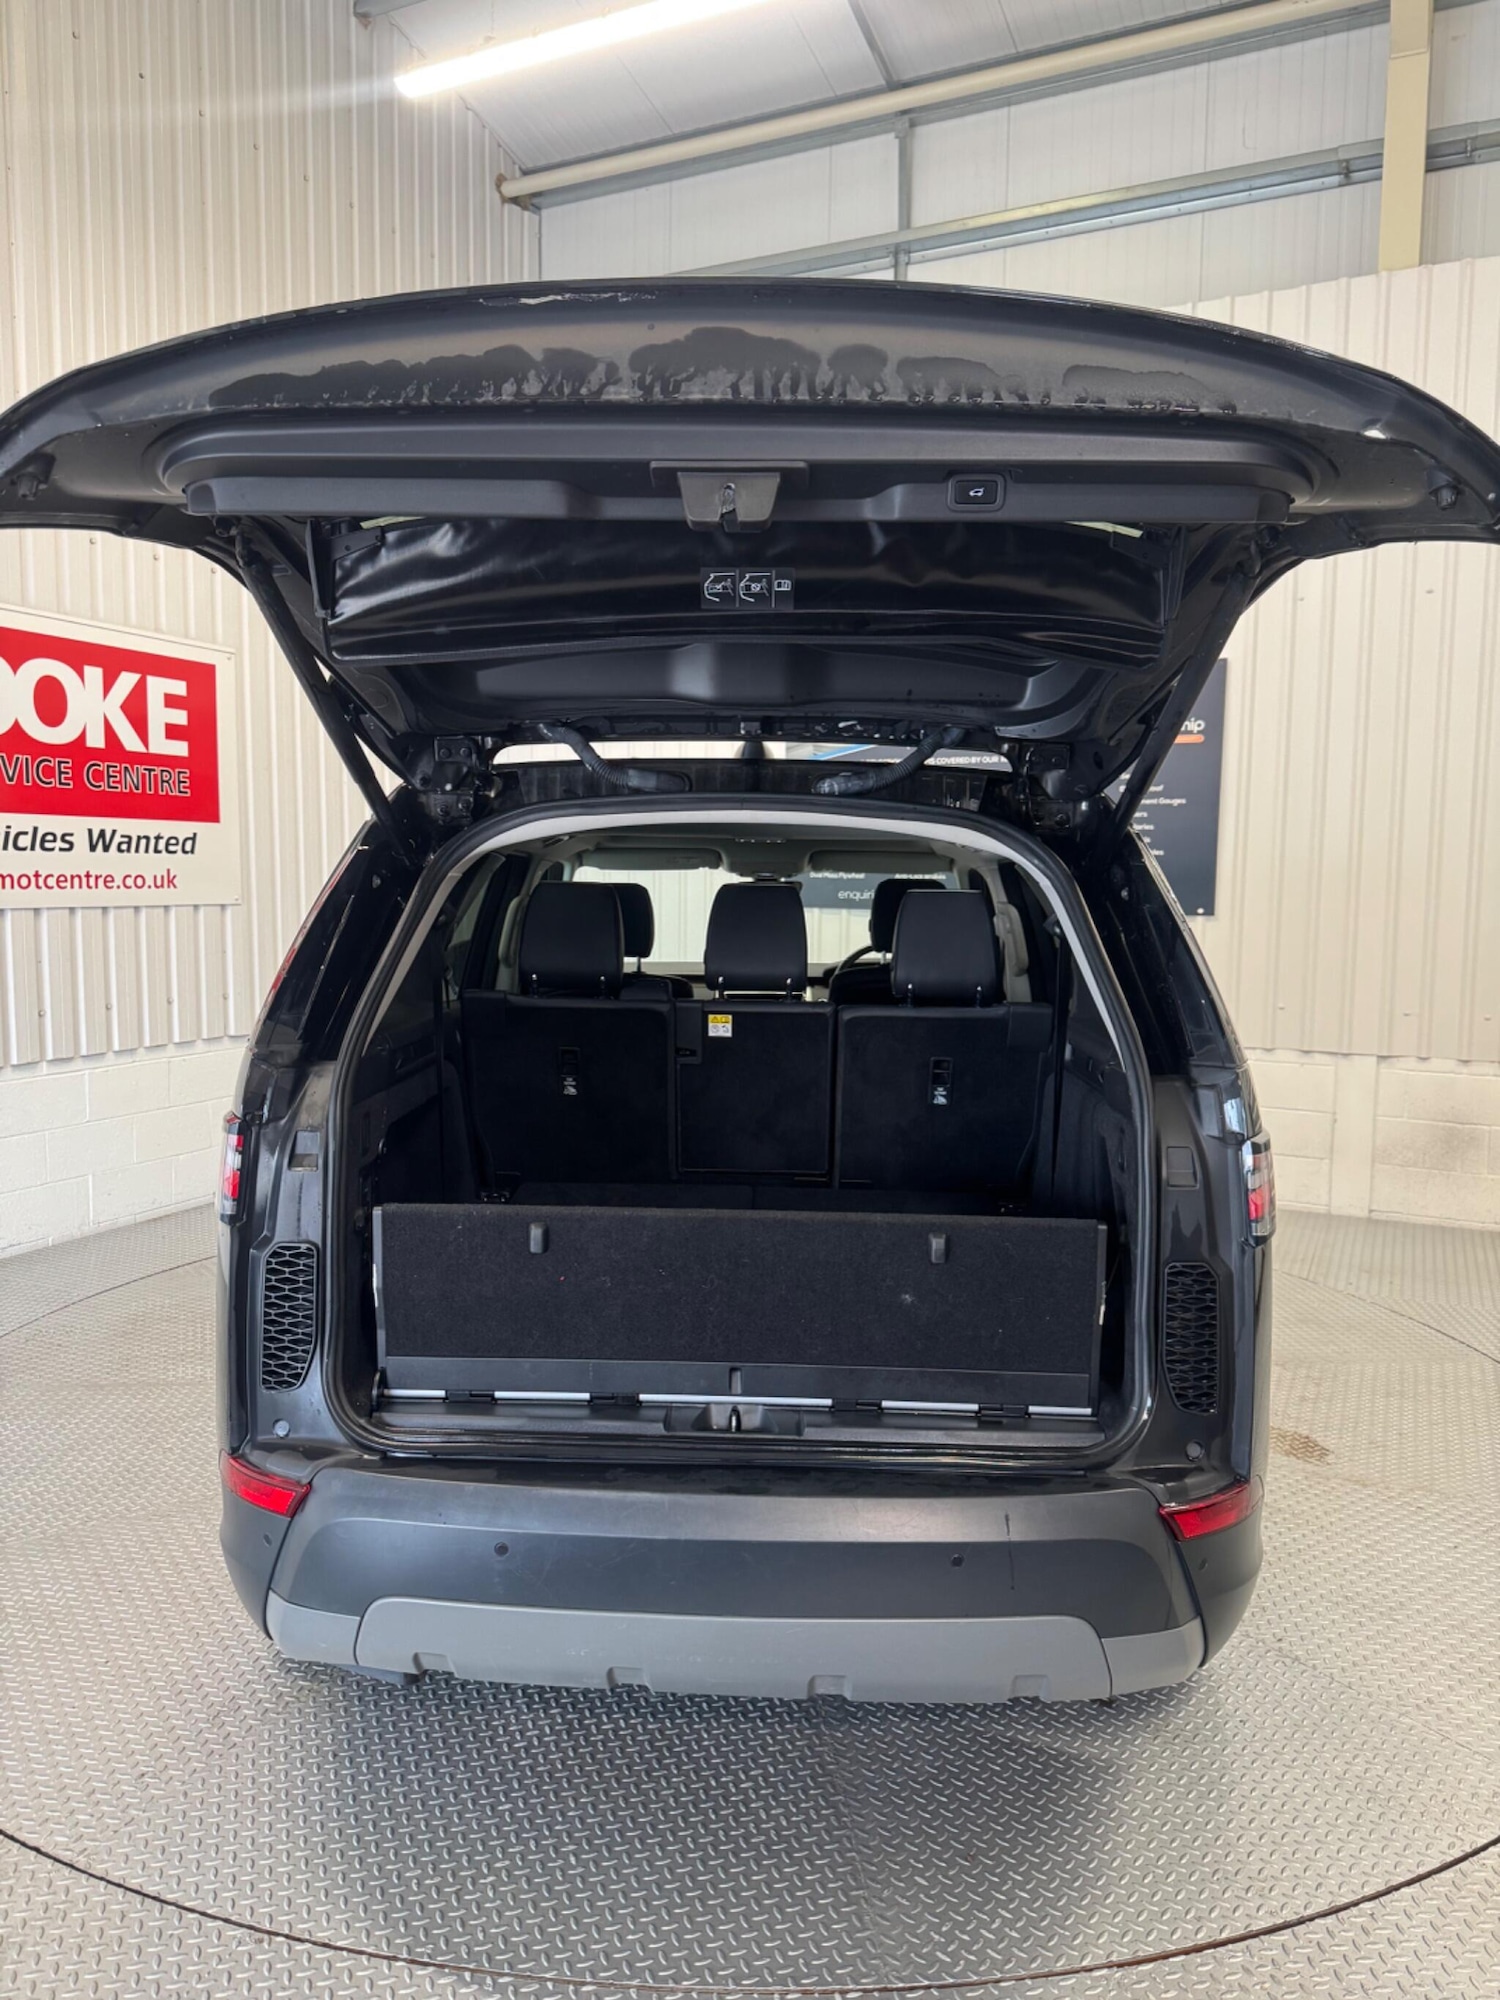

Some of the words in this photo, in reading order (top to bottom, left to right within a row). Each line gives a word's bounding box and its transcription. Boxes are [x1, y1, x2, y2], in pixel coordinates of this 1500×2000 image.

[0, 655, 189, 758] OKE
[936, 756, 970, 765] COVERED
[971, 756, 981, 764] BY
[982, 756, 999, 764] OUR
[84, 760, 192, 797] CENTRE
[1159, 797, 1187, 807] Gauges
[1, 825, 75, 853] icles
[87, 828, 198, 855] Wanted
[0, 868, 178, 890] motcentre.co.uk
